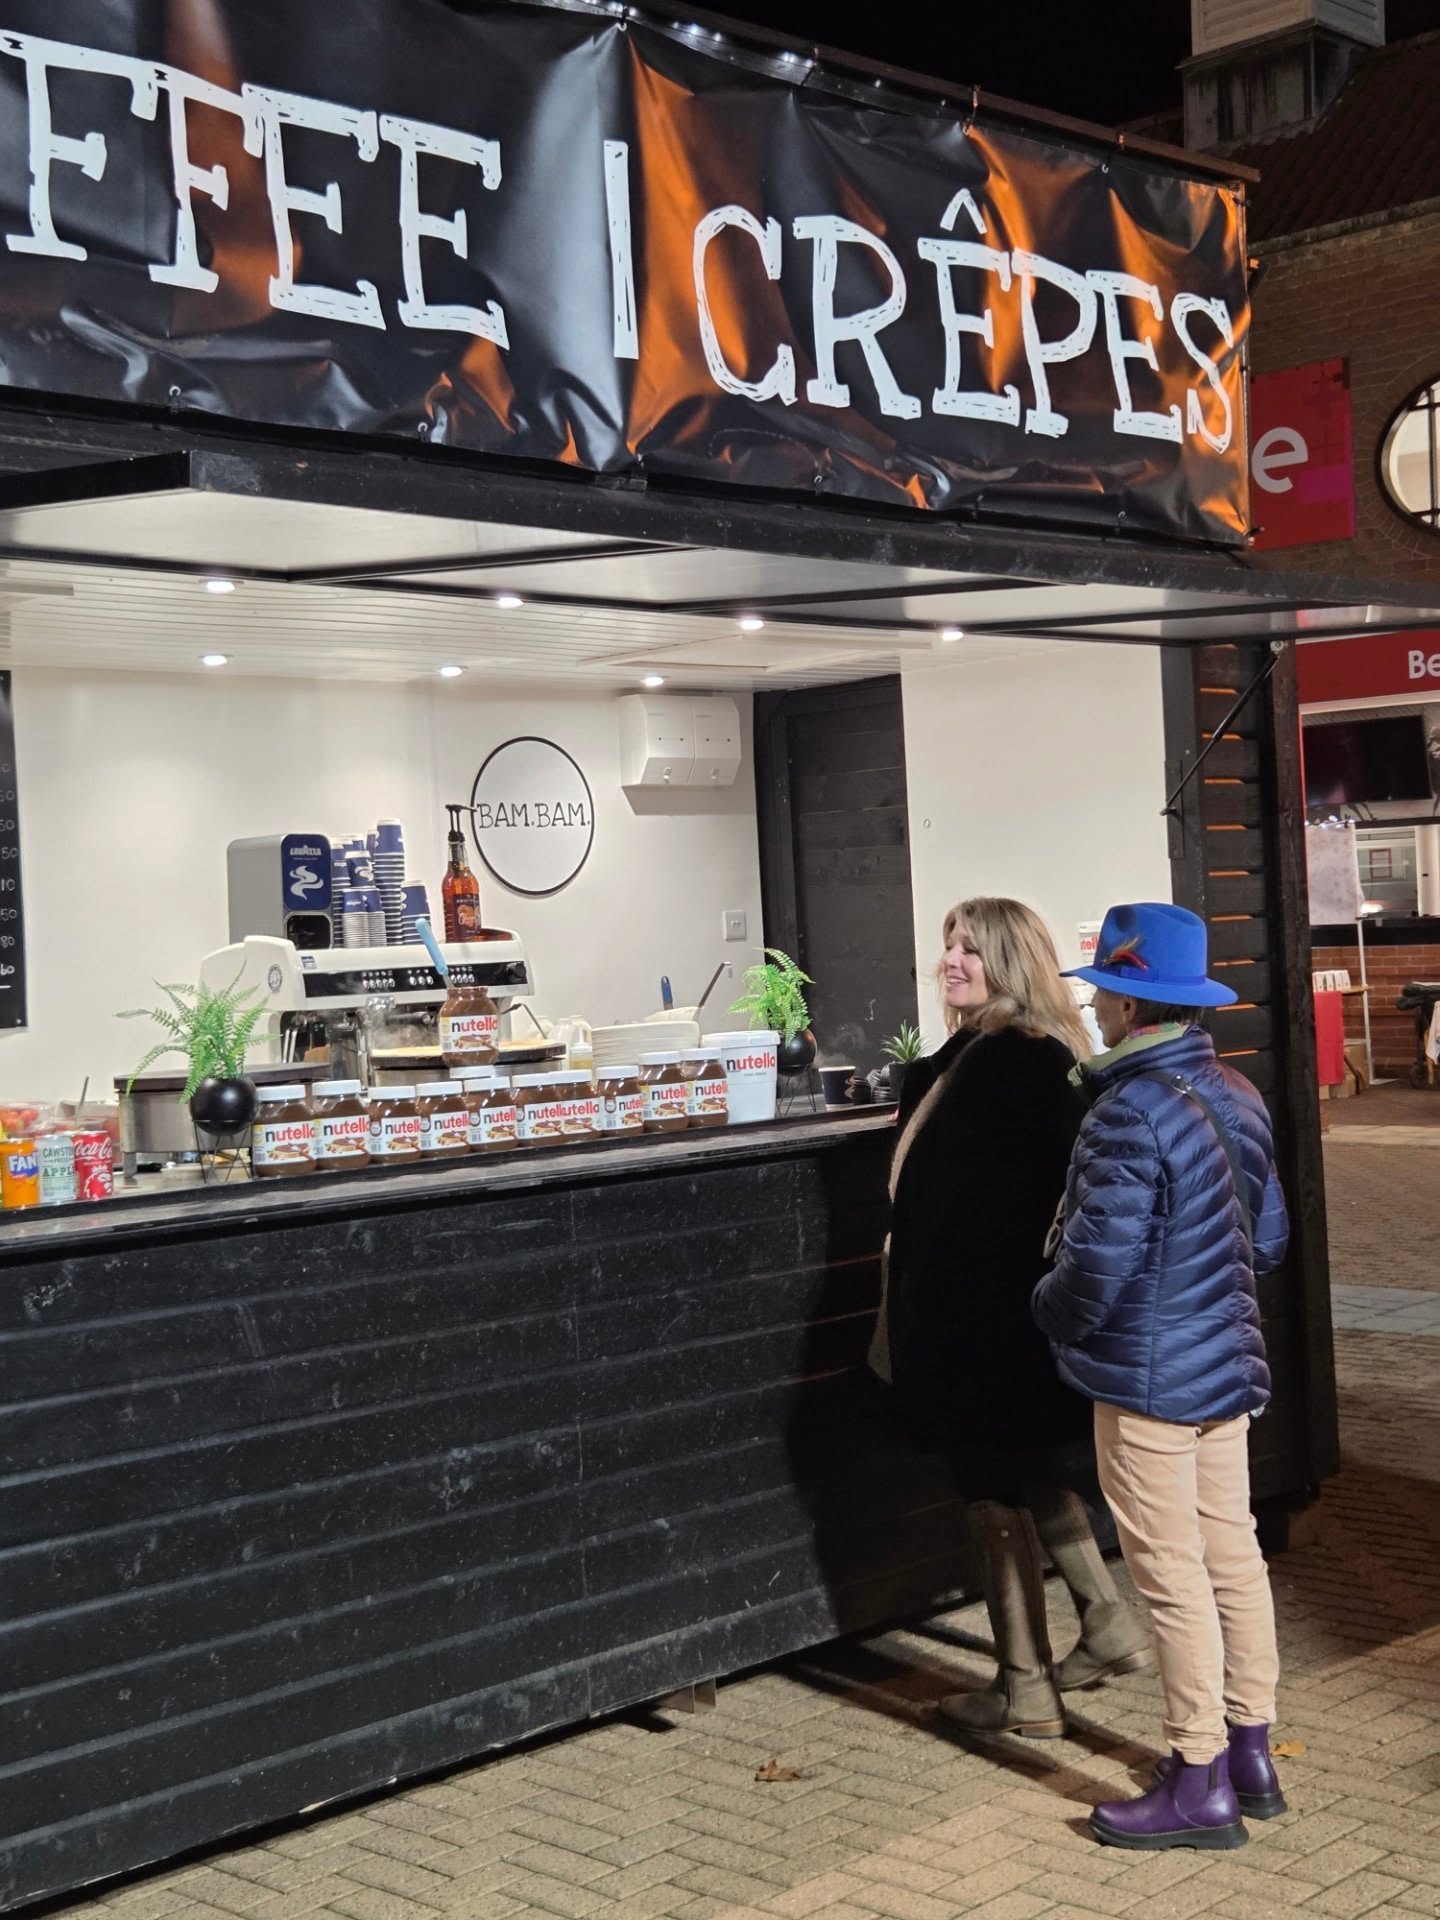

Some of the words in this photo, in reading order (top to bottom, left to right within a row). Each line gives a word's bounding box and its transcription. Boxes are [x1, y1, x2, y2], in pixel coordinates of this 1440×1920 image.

[692, 189, 1234, 455] CRÊPES
[1251, 426, 1309, 494] e
[725, 1052, 776, 1071] nutella
